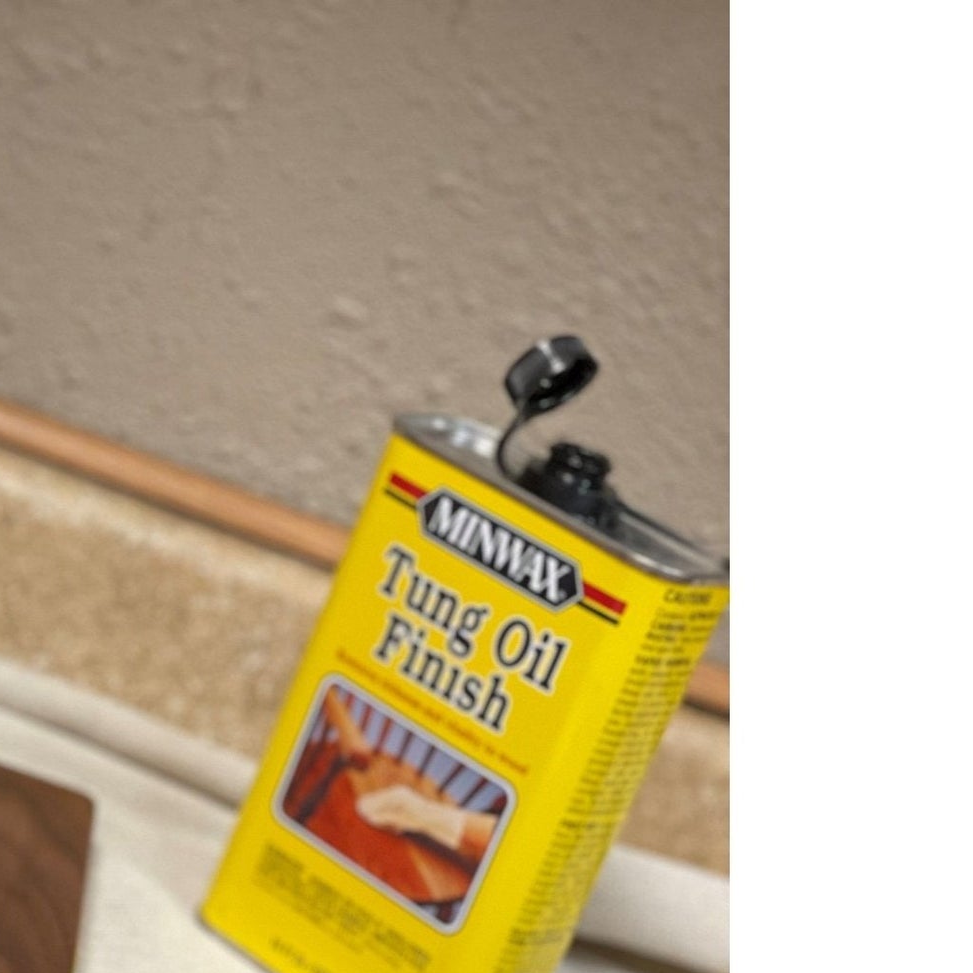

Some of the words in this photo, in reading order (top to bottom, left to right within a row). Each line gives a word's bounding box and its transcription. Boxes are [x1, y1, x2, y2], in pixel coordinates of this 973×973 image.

[427, 495, 572, 602] MINWAX
[376, 615, 508, 730] Finish
[384, 546, 489, 658] Tung
[495, 618, 567, 691] Oil
